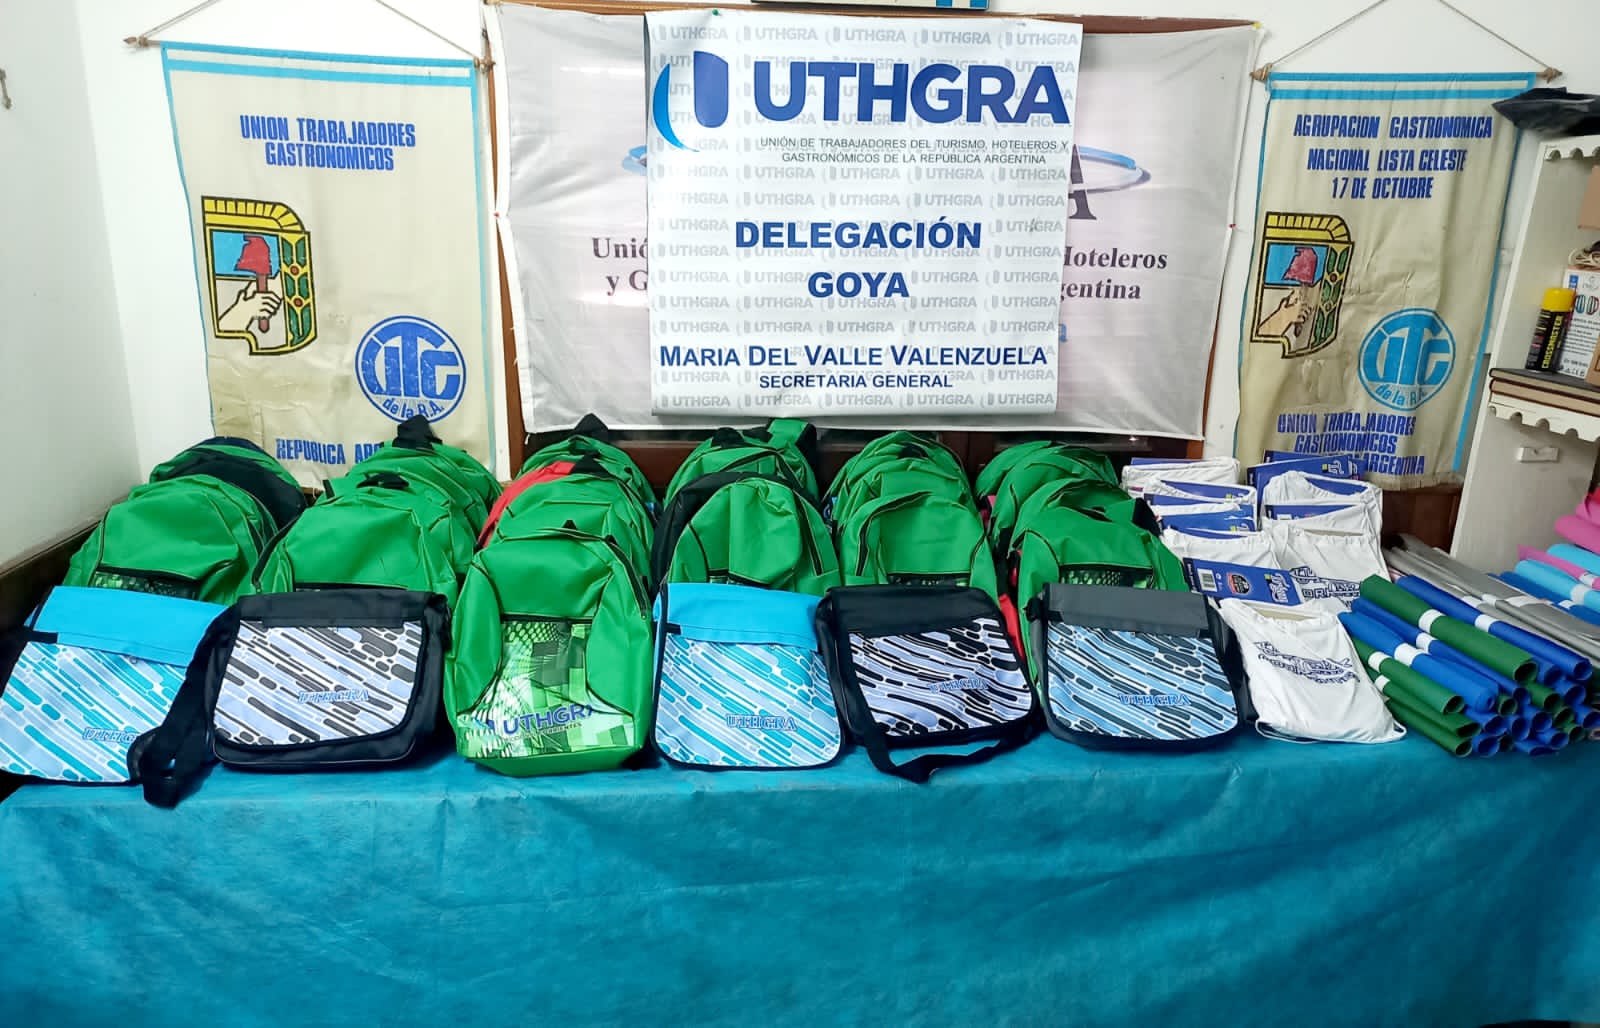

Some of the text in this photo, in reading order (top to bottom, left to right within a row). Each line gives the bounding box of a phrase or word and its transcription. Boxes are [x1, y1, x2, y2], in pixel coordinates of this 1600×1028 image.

[670, 26, 1078, 46] UTHGRA UTHGRA UTHGRA UTHGRA UTHGRA
[754, 61, 1070, 124] UTHGRA
[240, 115, 416, 147] UNION TRABAJADORES
[1293, 114, 1492, 138] AGRUPACION GASTRONOMICA
[760, 136, 797, 148] UNIÓN
[800, 138, 815, 148] DE
[820, 138, 907, 149] TRABAJADORES
[910, 139, 931, 149] DEL
[936, 139, 988, 150] TURISMO,
[991, 140, 1057, 150] HOTELEROS
[1061, 140, 1069, 150] Y
[265, 142, 394, 171] GASTRONOMICOS
[782, 151, 880, 163] GASTRONÓMICOS
[883, 153, 899, 163] DE
[902, 154, 918, 163] LA
[984, 154, 1046, 164] ARGENTINA
[1307, 148, 1467, 172] NACIONAL LISTA CELESTE
[755, 166, 815, 179] UTHGRA
[841, 167, 901, 180] UTHGRA
[926, 167, 985, 181] UTHGRA
[1009, 168, 1067, 181] UTHGRA
[1332, 177, 1433, 199] 17 DE OCTUBRE
[755, 192, 815, 205] UTHGRA
[840, 193, 901, 206] UTHGRA
[925, 194, 983, 206] UTHGRA
[1008, 194, 1065, 207] UTHGRA
[736, 216, 982, 249] DELEGACIÓN
[1007, 219, 1063, 232] UTHGRA
[592, 237, 648, 259] Unió
[669, 245, 729, 257] UTHGRA
[1005, 246, 1062, 257] UTHGRA
[670, 271, 729, 283] UTHGRA
[922, 271, 979, 283] UTHGRA
[1004, 272, 1060, 283] UTHGRA
[808, 271, 910, 298] GOYA
[670, 296, 1057, 309] UTHGRA UTHGRA UTHGRA UTHGRA UTHGRA
[671, 320, 1056, 333] UTHGRA UTHGRA UTHGRA UTHGRA UTHGRA
[659, 345, 741, 366] MARIA
[748, 345, 798, 366] DEL
[804, 345, 883, 366] VALLE
[890, 345, 1048, 366] VALENZUELA
[672, 369, 1055, 383] UTHGRA UTHGRA
[759, 375, 867, 389] SECRETARIA
[872, 375, 953, 388] GENERAL
[672, 392, 1054, 408] UTHGRA UTHGRA UTHGRA UTHGRA UTHGRA
[1277, 413, 1416, 436] UNION TRABAJADORES
[275, 438, 346, 465] REPUBLICA
[1294, 431, 1398, 454] GASTRONOMICOS
